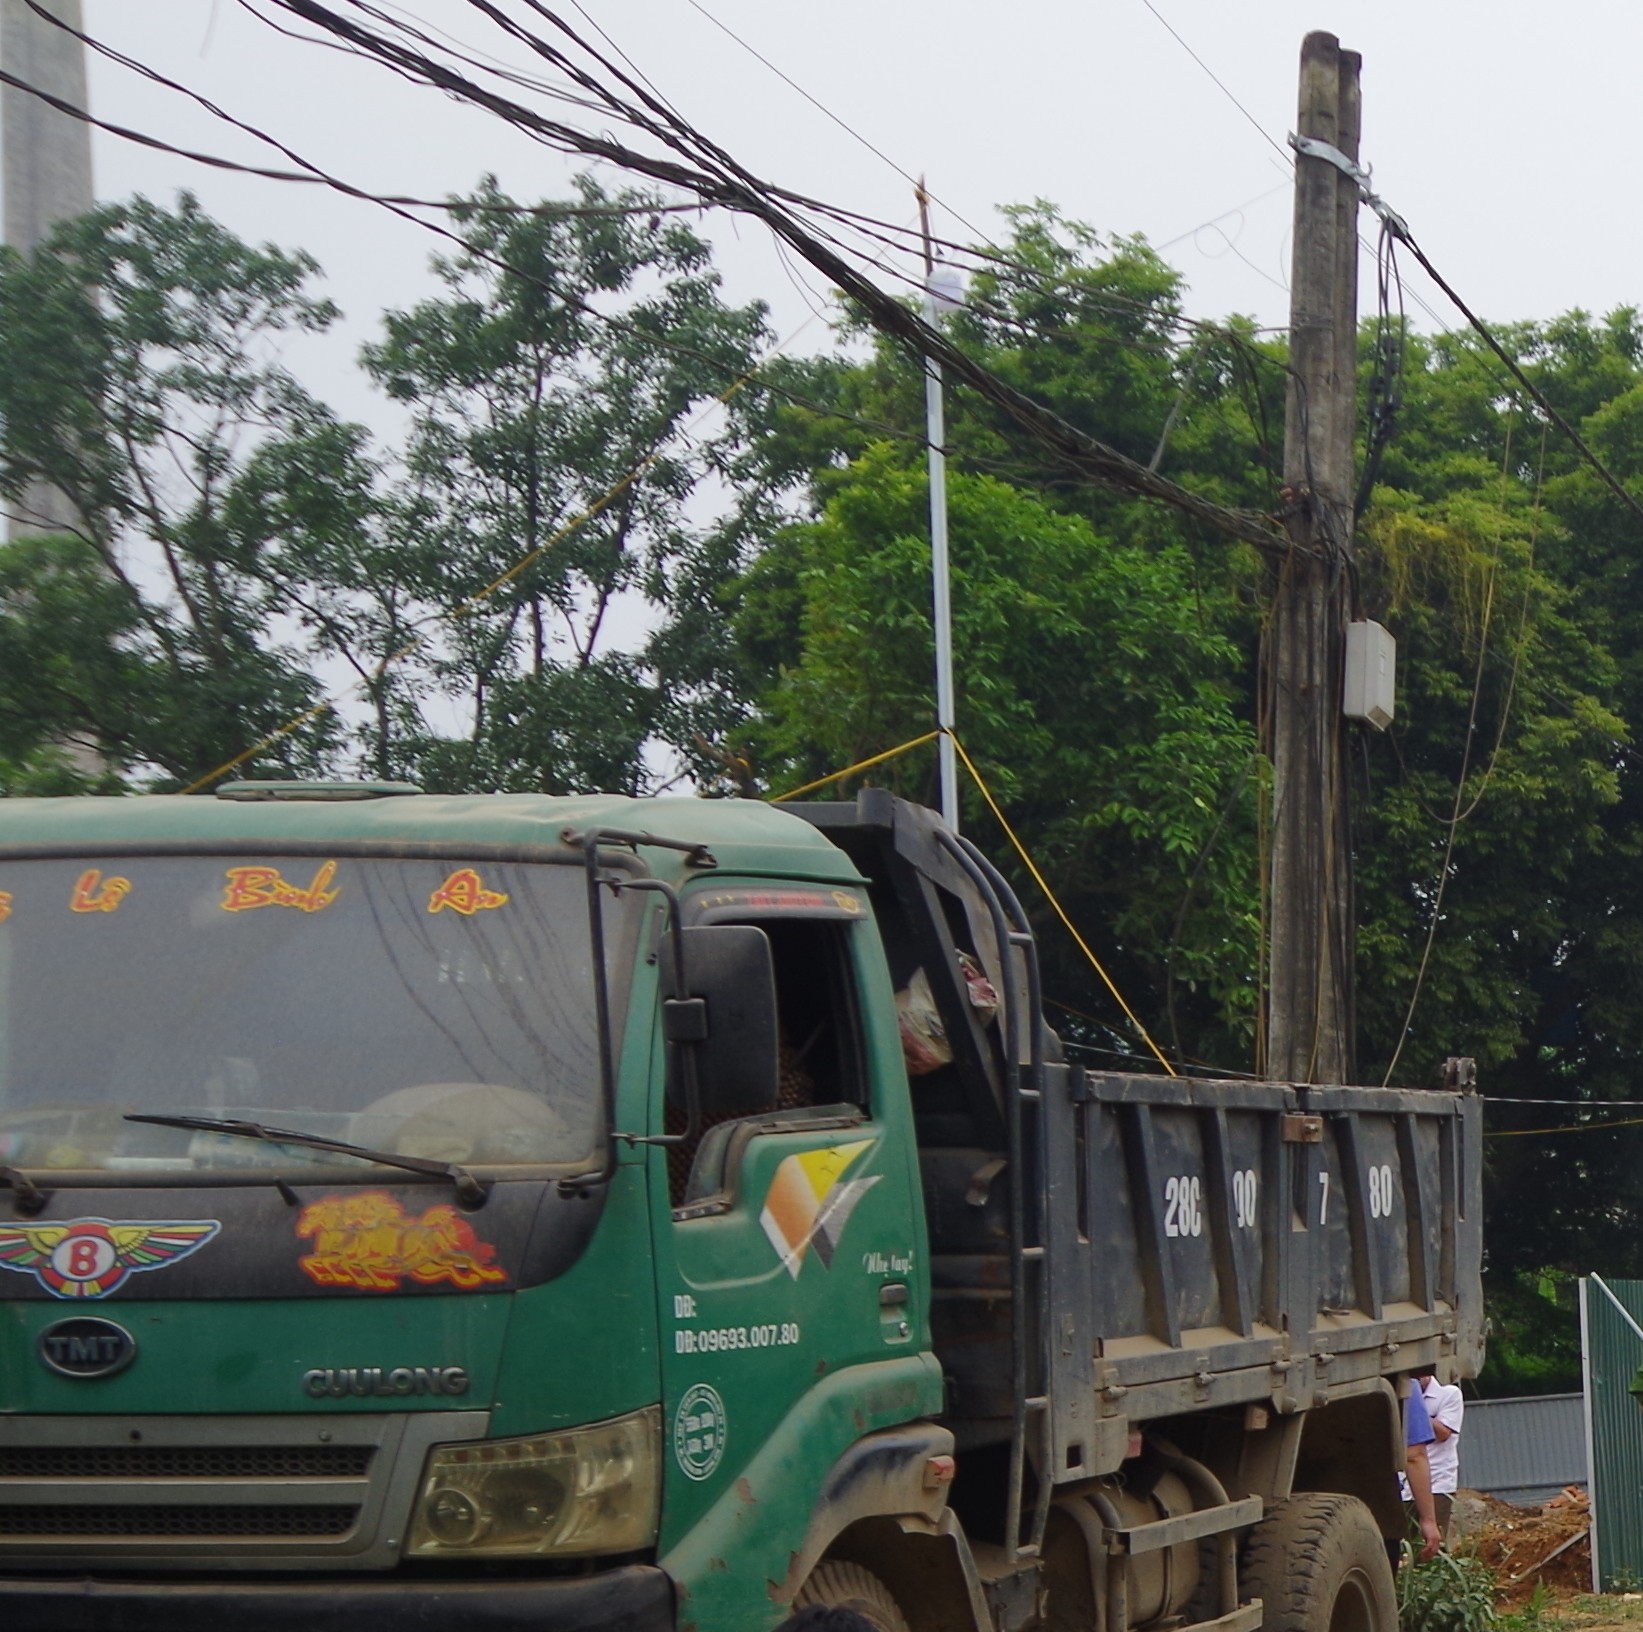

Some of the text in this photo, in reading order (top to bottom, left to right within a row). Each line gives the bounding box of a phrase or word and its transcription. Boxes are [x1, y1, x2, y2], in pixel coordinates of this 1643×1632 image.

[70, 868, 132, 913] Lê
[220, 859, 340, 912] Bình
[428, 868, 508, 916] An
[1164, 1176, 1201, 1237] 28C
[1319, 1172, 1329, 1225] 7
[1369, 1165, 1393, 1219] 80
[68, 1239, 99, 1277] B
[47, 1337, 119, 1361] TMT
[303, 1367, 469, 1397] CUULONG
